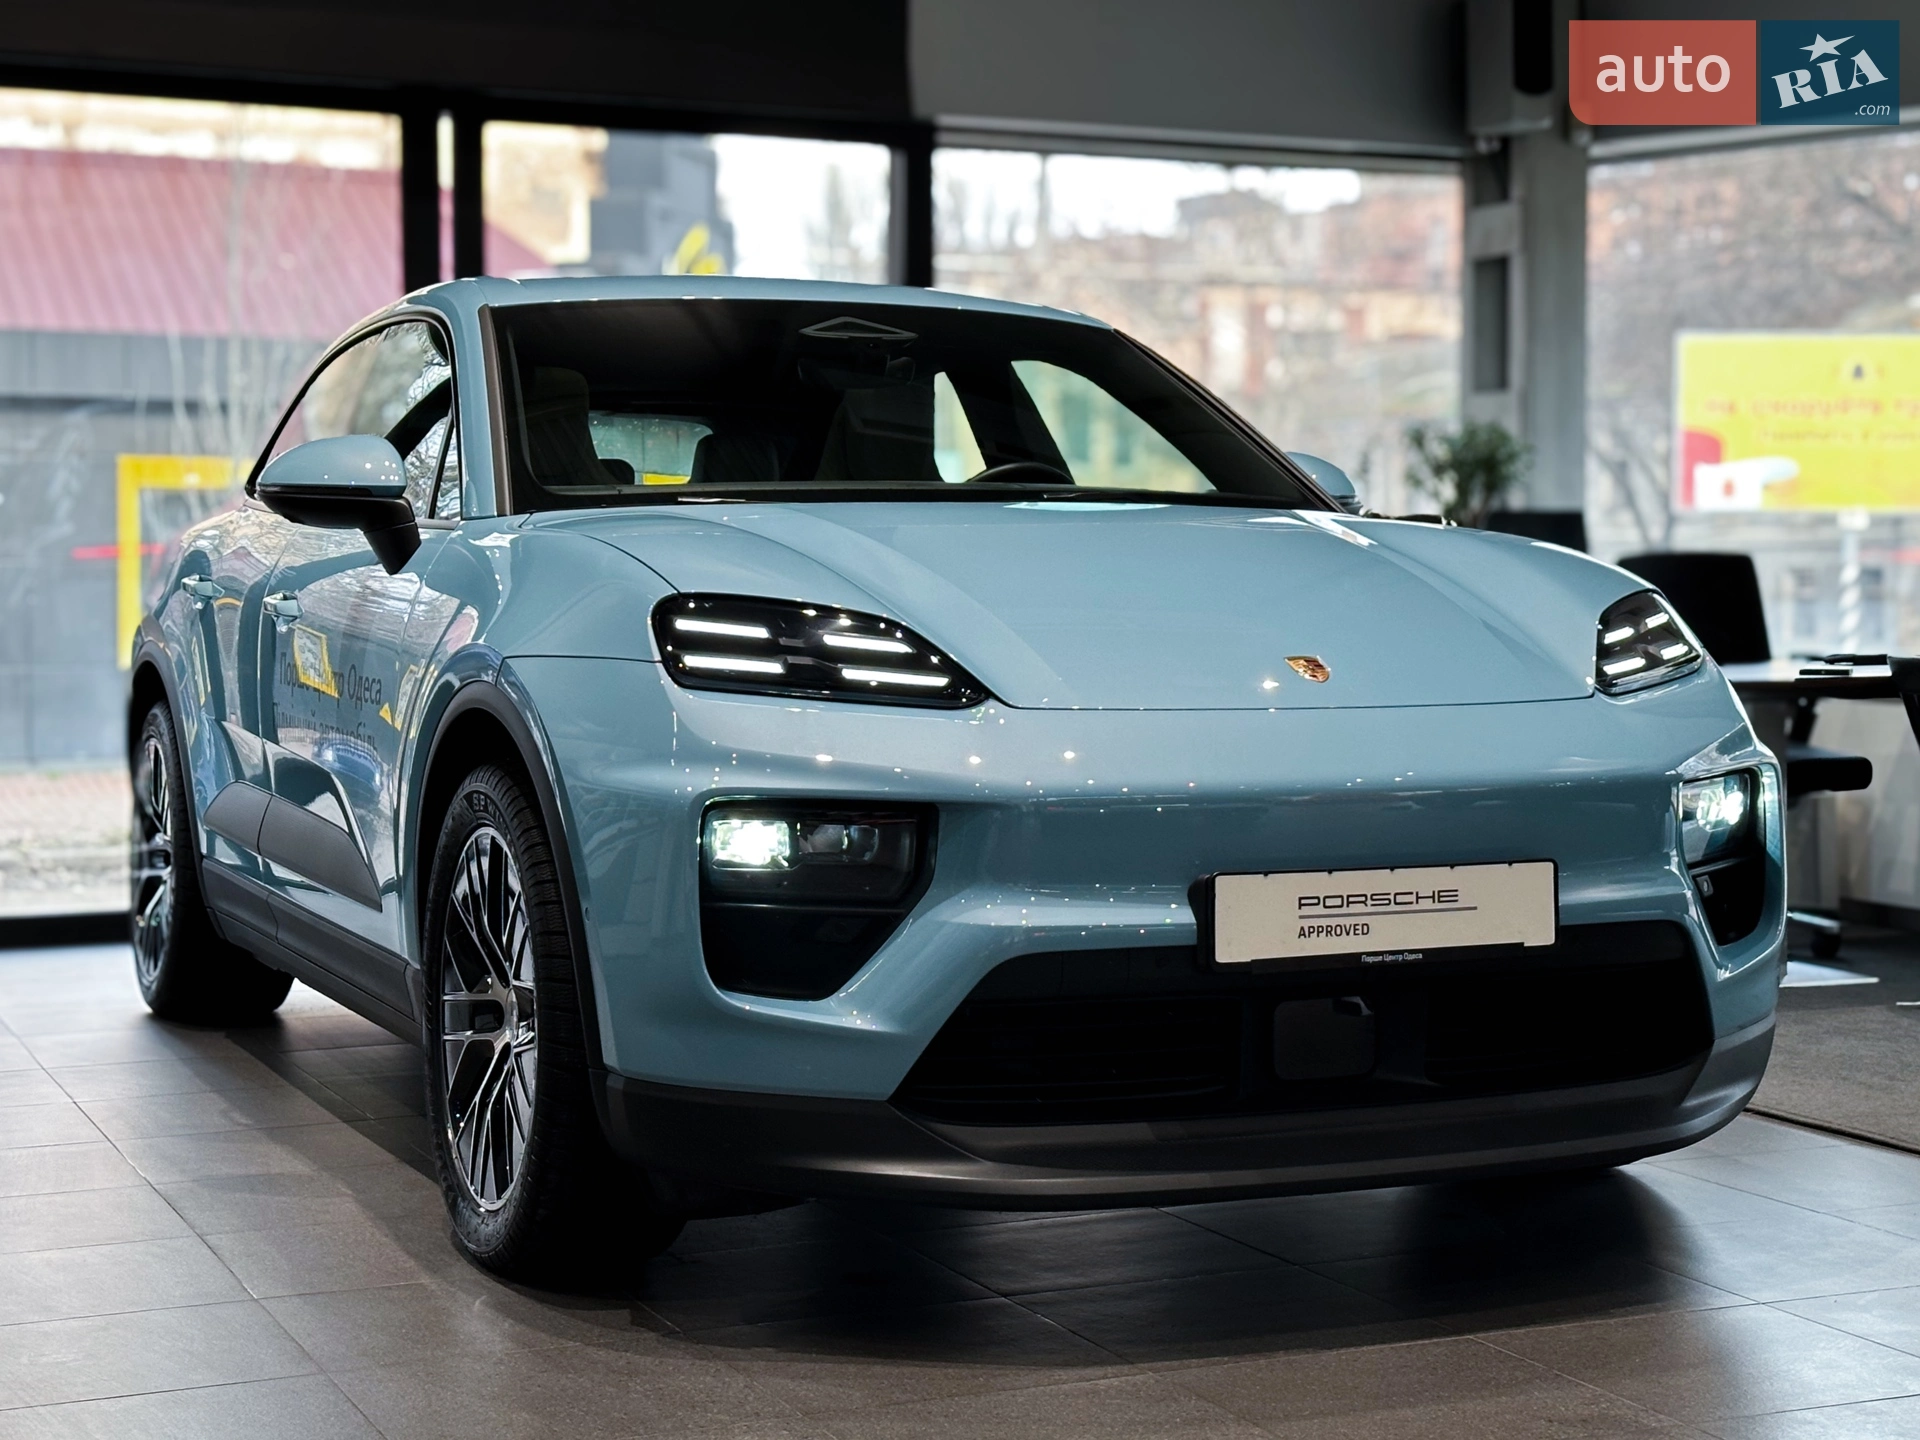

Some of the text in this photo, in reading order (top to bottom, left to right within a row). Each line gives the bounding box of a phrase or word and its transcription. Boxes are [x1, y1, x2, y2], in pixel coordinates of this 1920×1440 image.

[348, 664, 382, 710] Одеса
[1298, 889, 1459, 910] PORSCHE
[1298, 923, 1370, 939] APPROVED
[1361, 952, 1422, 963] Порше Центр Одеса
